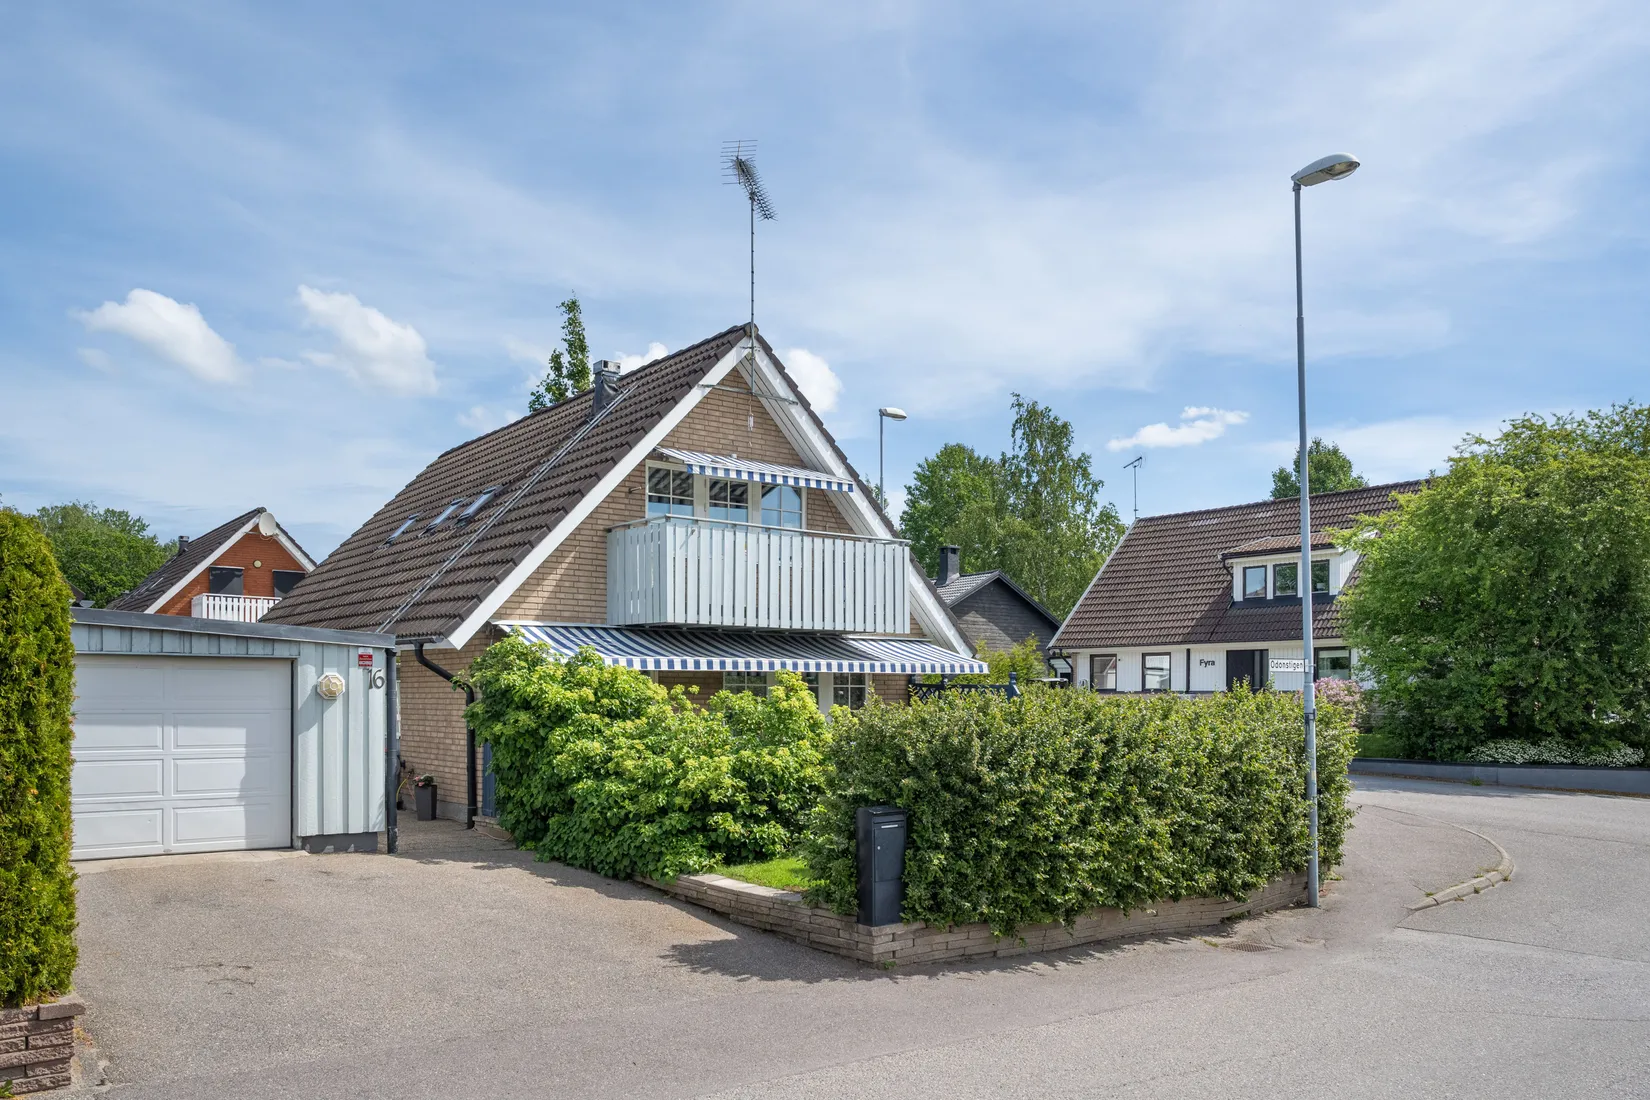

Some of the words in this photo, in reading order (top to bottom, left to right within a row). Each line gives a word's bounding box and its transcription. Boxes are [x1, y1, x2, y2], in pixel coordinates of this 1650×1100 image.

[1199, 659, 1215, 668] Fyra
[1270, 660, 1303, 670] Odonstigen
[368, 669, 385, 689] 16
